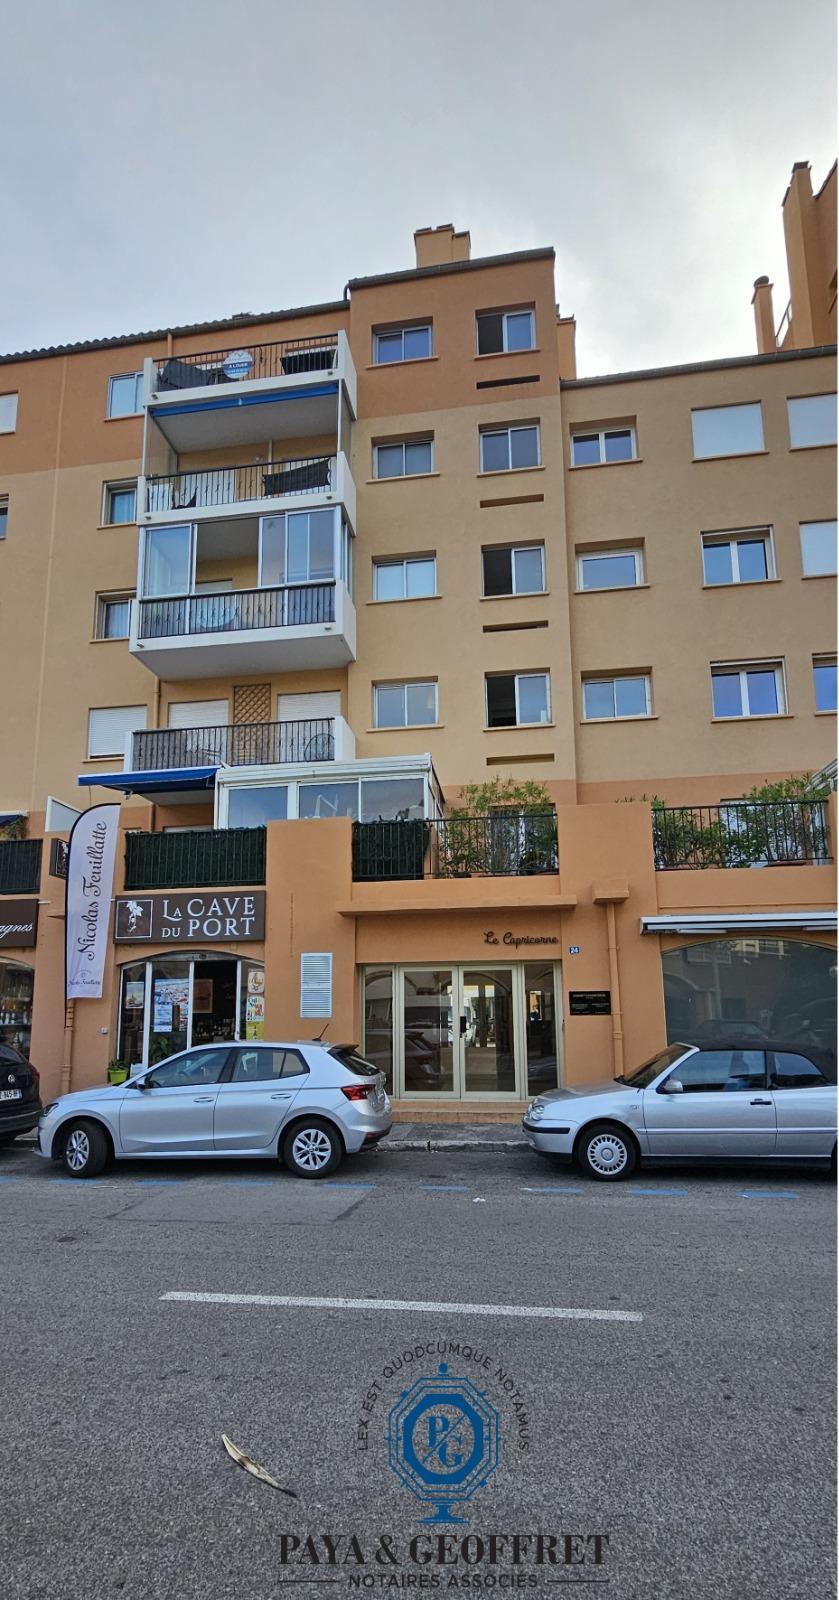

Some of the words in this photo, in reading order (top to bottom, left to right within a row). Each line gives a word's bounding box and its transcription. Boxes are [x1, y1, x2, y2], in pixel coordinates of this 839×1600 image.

[83, 820, 108, 897] Feuillatte
[187, 896, 255, 917] CAVE
[78, 901, 99, 961] Nicolas
[162, 927, 180, 938] DU
[187, 917, 255, 937] PORT
[483, 931, 499, 945] Le
[502, 931, 559, 949] Capricorne
